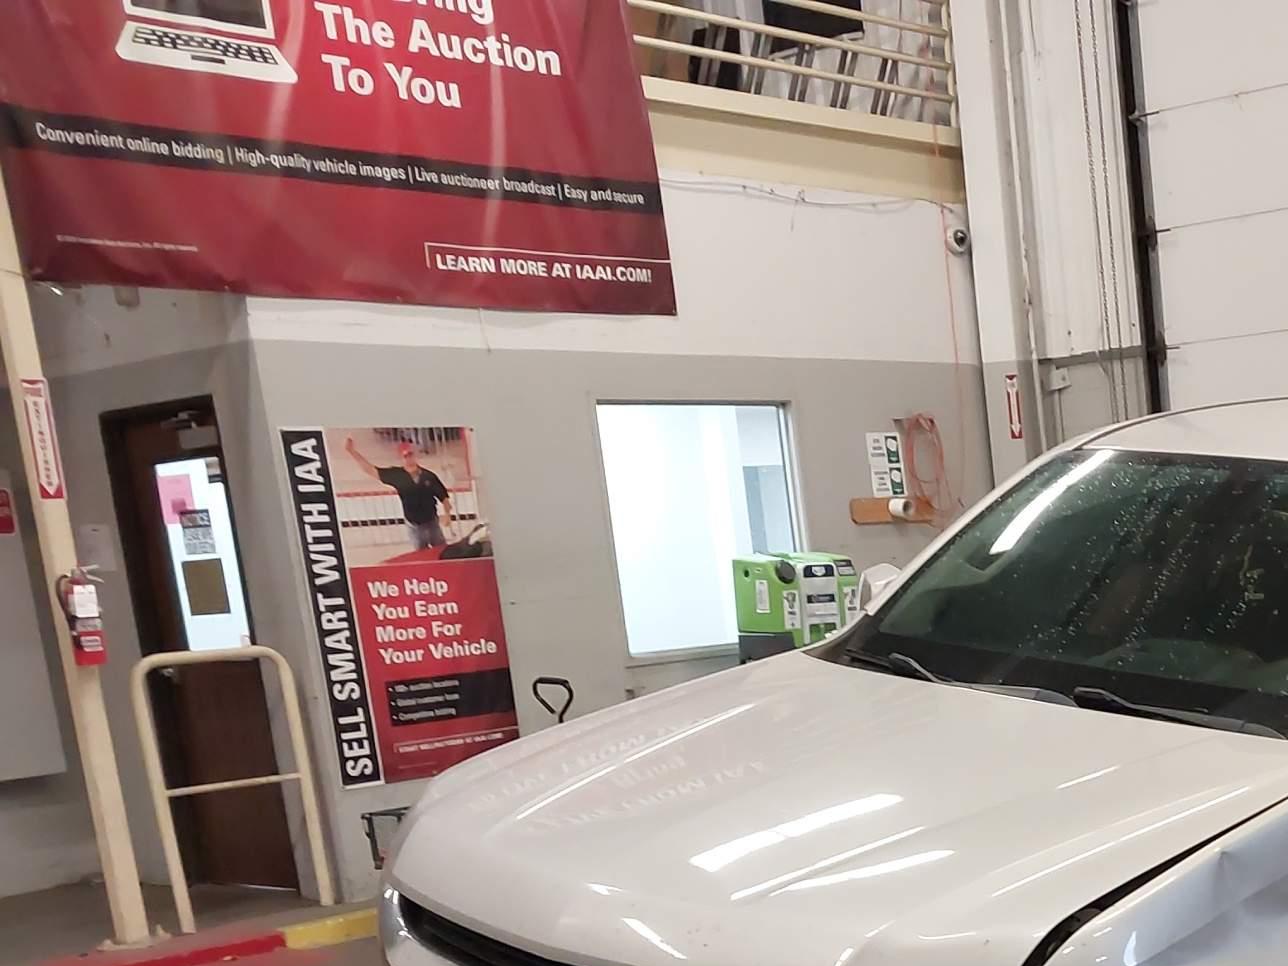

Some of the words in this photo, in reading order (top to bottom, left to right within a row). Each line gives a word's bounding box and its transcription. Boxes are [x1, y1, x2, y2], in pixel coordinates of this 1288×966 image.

[314, 1, 395, 48] The
[408, 18, 562, 76] Auction
[320, 53, 375, 96] To
[383, 62, 462, 108] You
[35, 121, 126, 149] Convenient
[127, 137, 169, 155] online
[171, 140, 225, 165] bidding
[234, 146, 312, 173] High-quality
[312, 157, 357, 176] vehicle
[358, 161, 406, 182] images
[414, 166, 438, 184] Live
[440, 173, 500, 191] auctioneer
[502, 176, 556, 197] broadcast
[564, 184, 588, 202] Easy
[590, 188, 613, 201] and
[613, 191, 644, 204] secure
[435, 253, 495, 273] LEARN
[500, 258, 548, 277] MORE
[551, 262, 573, 279] AT
[575, 263, 653, 283] IAAI.COM!
[290, 437, 326, 492] IAA
[299, 502, 342, 586] WITH
[367, 581, 399, 598] We
[403, 577, 448, 596] Help
[371, 604, 410, 620] You
[415, 600, 459, 617] Earn
[317, 593, 361, 701] SMART
[375, 626, 426, 643] More
[431, 621, 463, 638] For
[378, 648, 424, 665] Your
[428, 638, 497, 660] Vehicle
[339, 706, 374, 777] SELL
